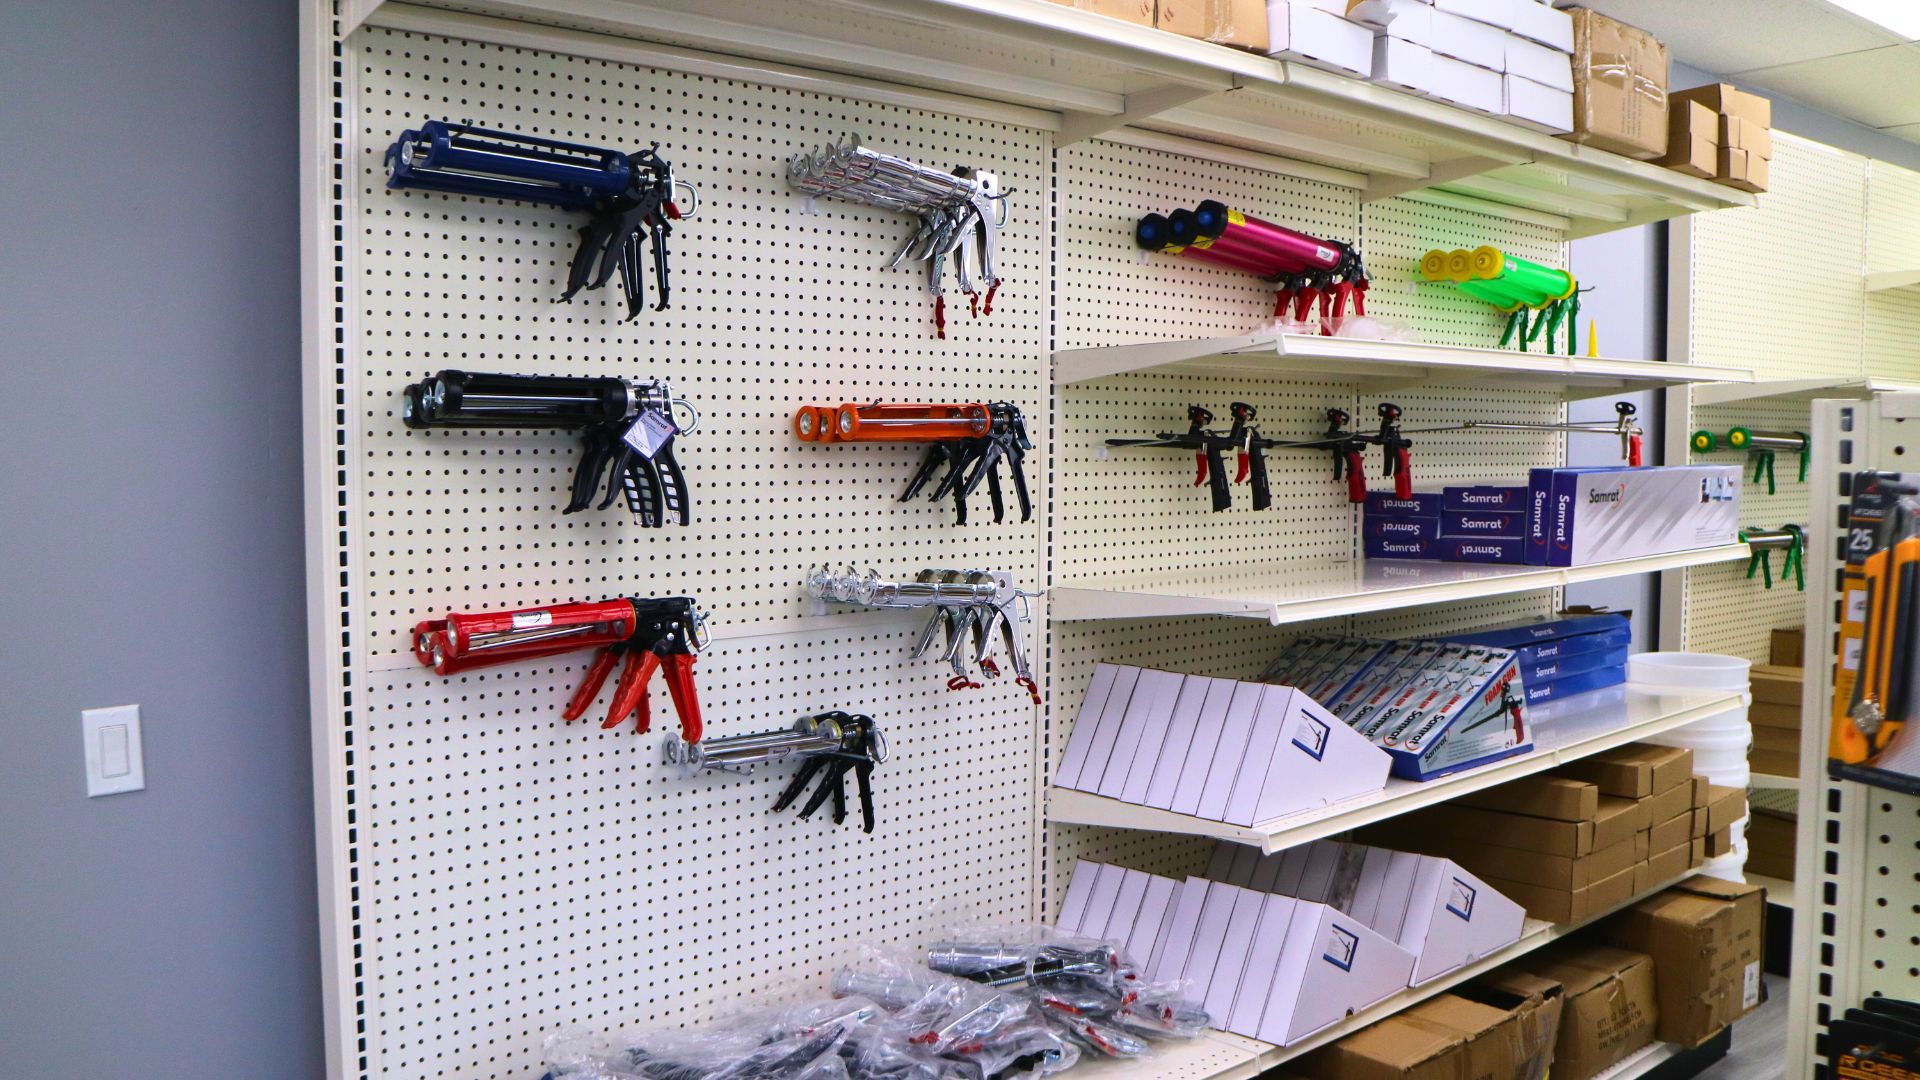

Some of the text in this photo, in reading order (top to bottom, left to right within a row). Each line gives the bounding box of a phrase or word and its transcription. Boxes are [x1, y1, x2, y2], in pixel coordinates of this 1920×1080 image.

[1462, 492, 1503, 504] Samrat
[1588, 487, 1620, 504] Samrat
[1383, 499, 1421, 512] Samrat
[1532, 490, 1546, 538] Samrat
[1556, 494, 1570, 541] Samrat
[1383, 523, 1421, 535] Samrat
[1461, 517, 1502, 529] Samrat
[1383, 541, 1421, 552] Samrat
[1850, 528, 1873, 551] 25
[1462, 545, 1502, 558] Samrat
[1537, 646, 1558, 658] Samrat
[1536, 665, 1556, 677] Samrat
[1484, 665, 1516, 706] FOAM GUN
[1529, 687, 1551, 699] Samrat
[1364, 707, 1399, 737] Samrat
[1388, 710, 1423, 741] Samrat
[1409, 714, 1445, 745] Samrat
[1424, 735, 1447, 762] Samrat
